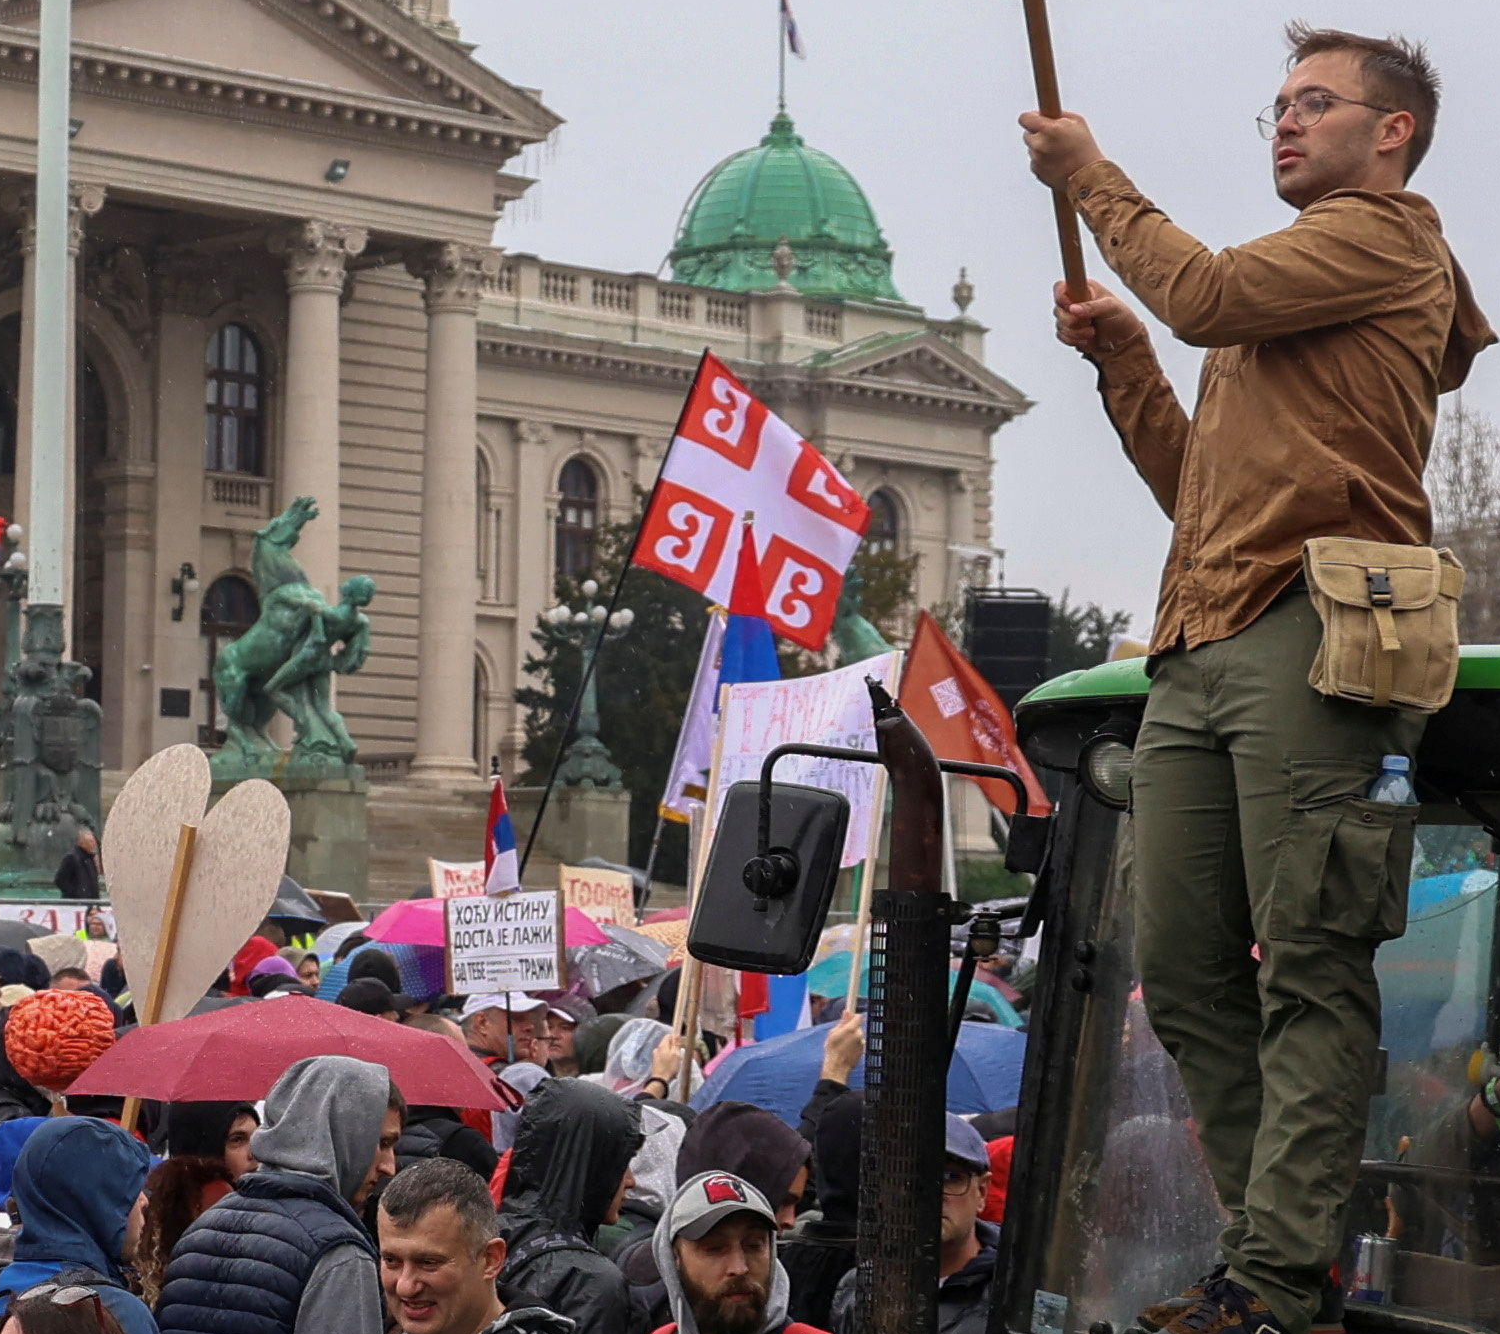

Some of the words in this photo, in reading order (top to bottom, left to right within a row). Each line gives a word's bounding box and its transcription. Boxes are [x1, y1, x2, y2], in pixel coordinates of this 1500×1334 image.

[455, 904, 491, 925] ХОЋУ
[494, 900, 550, 922] ИСТИНУ
[454, 929, 494, 953] ДОСТА
[497, 928, 508, 946] ЈЕ
[512, 926, 552, 945] ЛАЖИ
[454, 962, 467, 985] ОД
[467, 961, 486, 980] ТЕБЕ
[519, 957, 554, 981] ТРАЖИ
